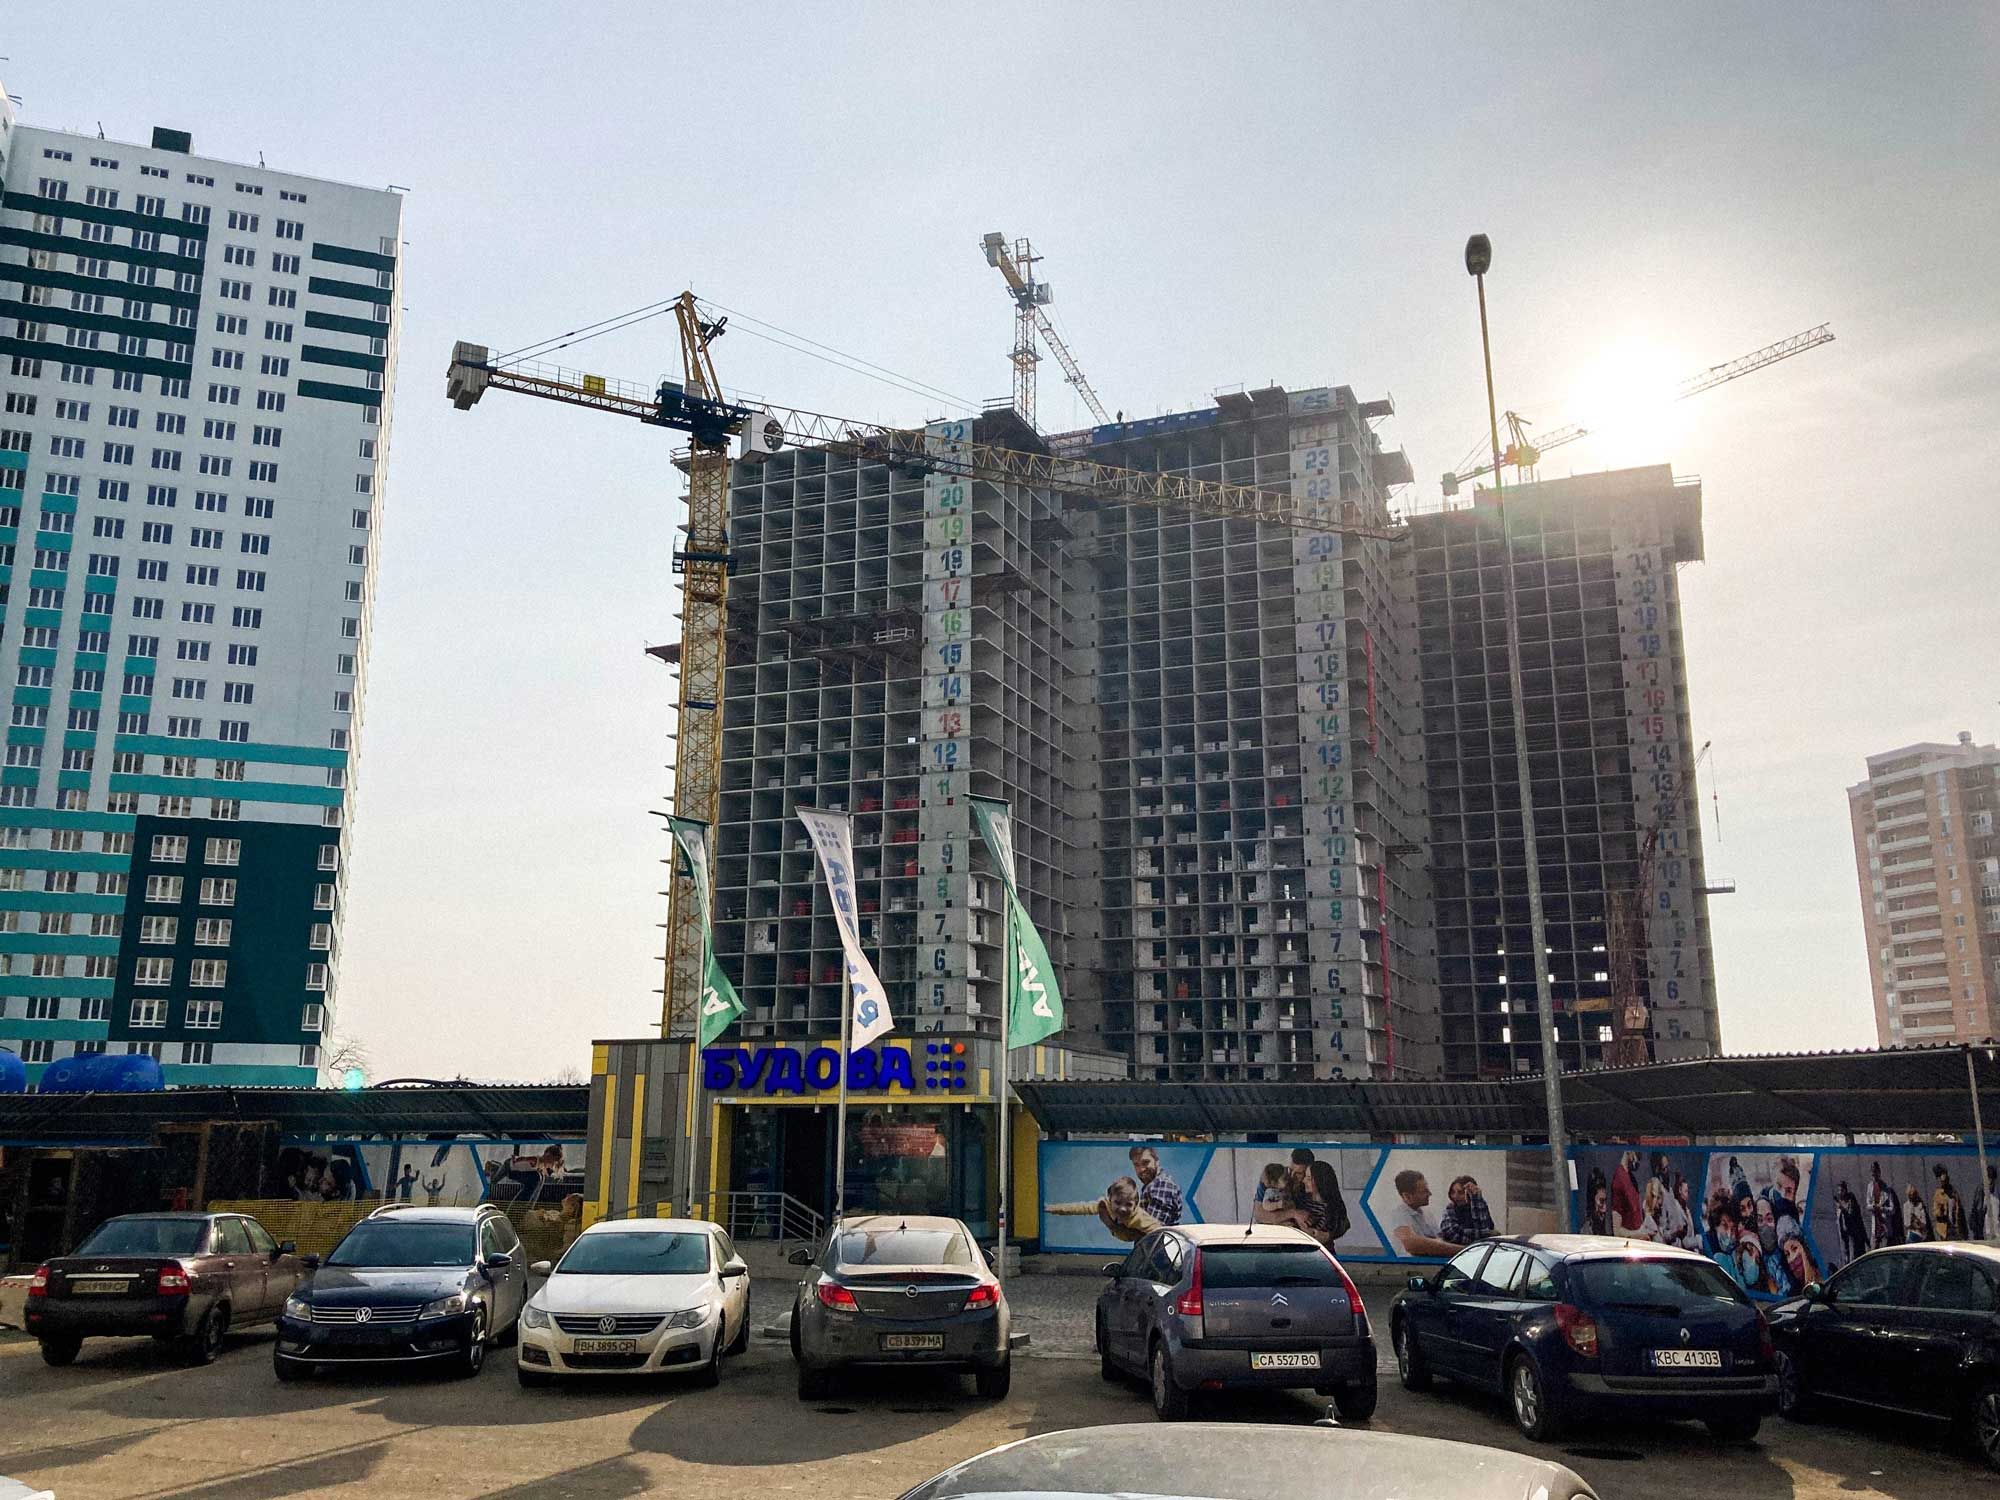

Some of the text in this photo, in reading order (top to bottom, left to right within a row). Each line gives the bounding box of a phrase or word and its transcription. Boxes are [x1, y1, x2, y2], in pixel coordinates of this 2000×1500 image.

[1305, 448, 1329, 471] 23
[940, 485, 964, 508] 20
[1307, 478, 1331, 498] 22
[940, 516, 963, 539] 19
[1309, 534, 1334, 555] 20
[940, 548, 962, 571] 18
[940, 580, 960, 601] 17
[940, 611, 961, 633] 16
[1315, 622, 1336, 641] 17
[939, 643, 962, 665] 15
[1313, 653, 1339, 674] 16
[939, 677, 961, 698] 14
[1316, 683, 1339, 704] 15
[1643, 688, 1665, 708] 16
[938, 712, 961, 733] 13
[1316, 714, 1340, 734] 14
[1641, 716, 1664, 735] 15
[933, 742, 957, 764] 12
[1318, 744, 1342, 765] 13
[1648, 744, 1671, 764] 14
[937, 778, 950, 796] 11
[1318, 775, 1344, 796] 12
[1650, 773, 1673, 793] 13
[1323, 805, 1345, 826] 11
[1323, 836, 1346, 857] 10
[1657, 831, 1678, 849] 11
[941, 843, 953, 865] 9
[937, 877, 948, 898] 8
[1329, 868, 1342, 888] 9
[1329, 900, 1343, 921] 8
[1659, 891, 1671, 912] 9
[934, 913, 946, 935] 7
[1330, 933, 1342, 953] 7
[934, 948, 946, 971] 6
[1670, 949, 1681, 969] 7
[1327, 968, 1340, 989] 6
[933, 984, 945, 1007] 5
[1667, 979, 1679, 1000] 6
[1331, 998, 1343, 1019] 5
[1667, 1018, 1681, 1040] 5
[1330, 1031, 1343, 1051] 4
[702, 1046, 915, 1094] БУДОВА
[580, 1341, 594, 1351] BH
[928, 1336, 942, 1346] MA
[1260, 1355, 1316, 1366] CA 5527 BO
[1656, 1351, 1680, 1365] KBC
[1684, 1351, 1719, 1365] 41303
